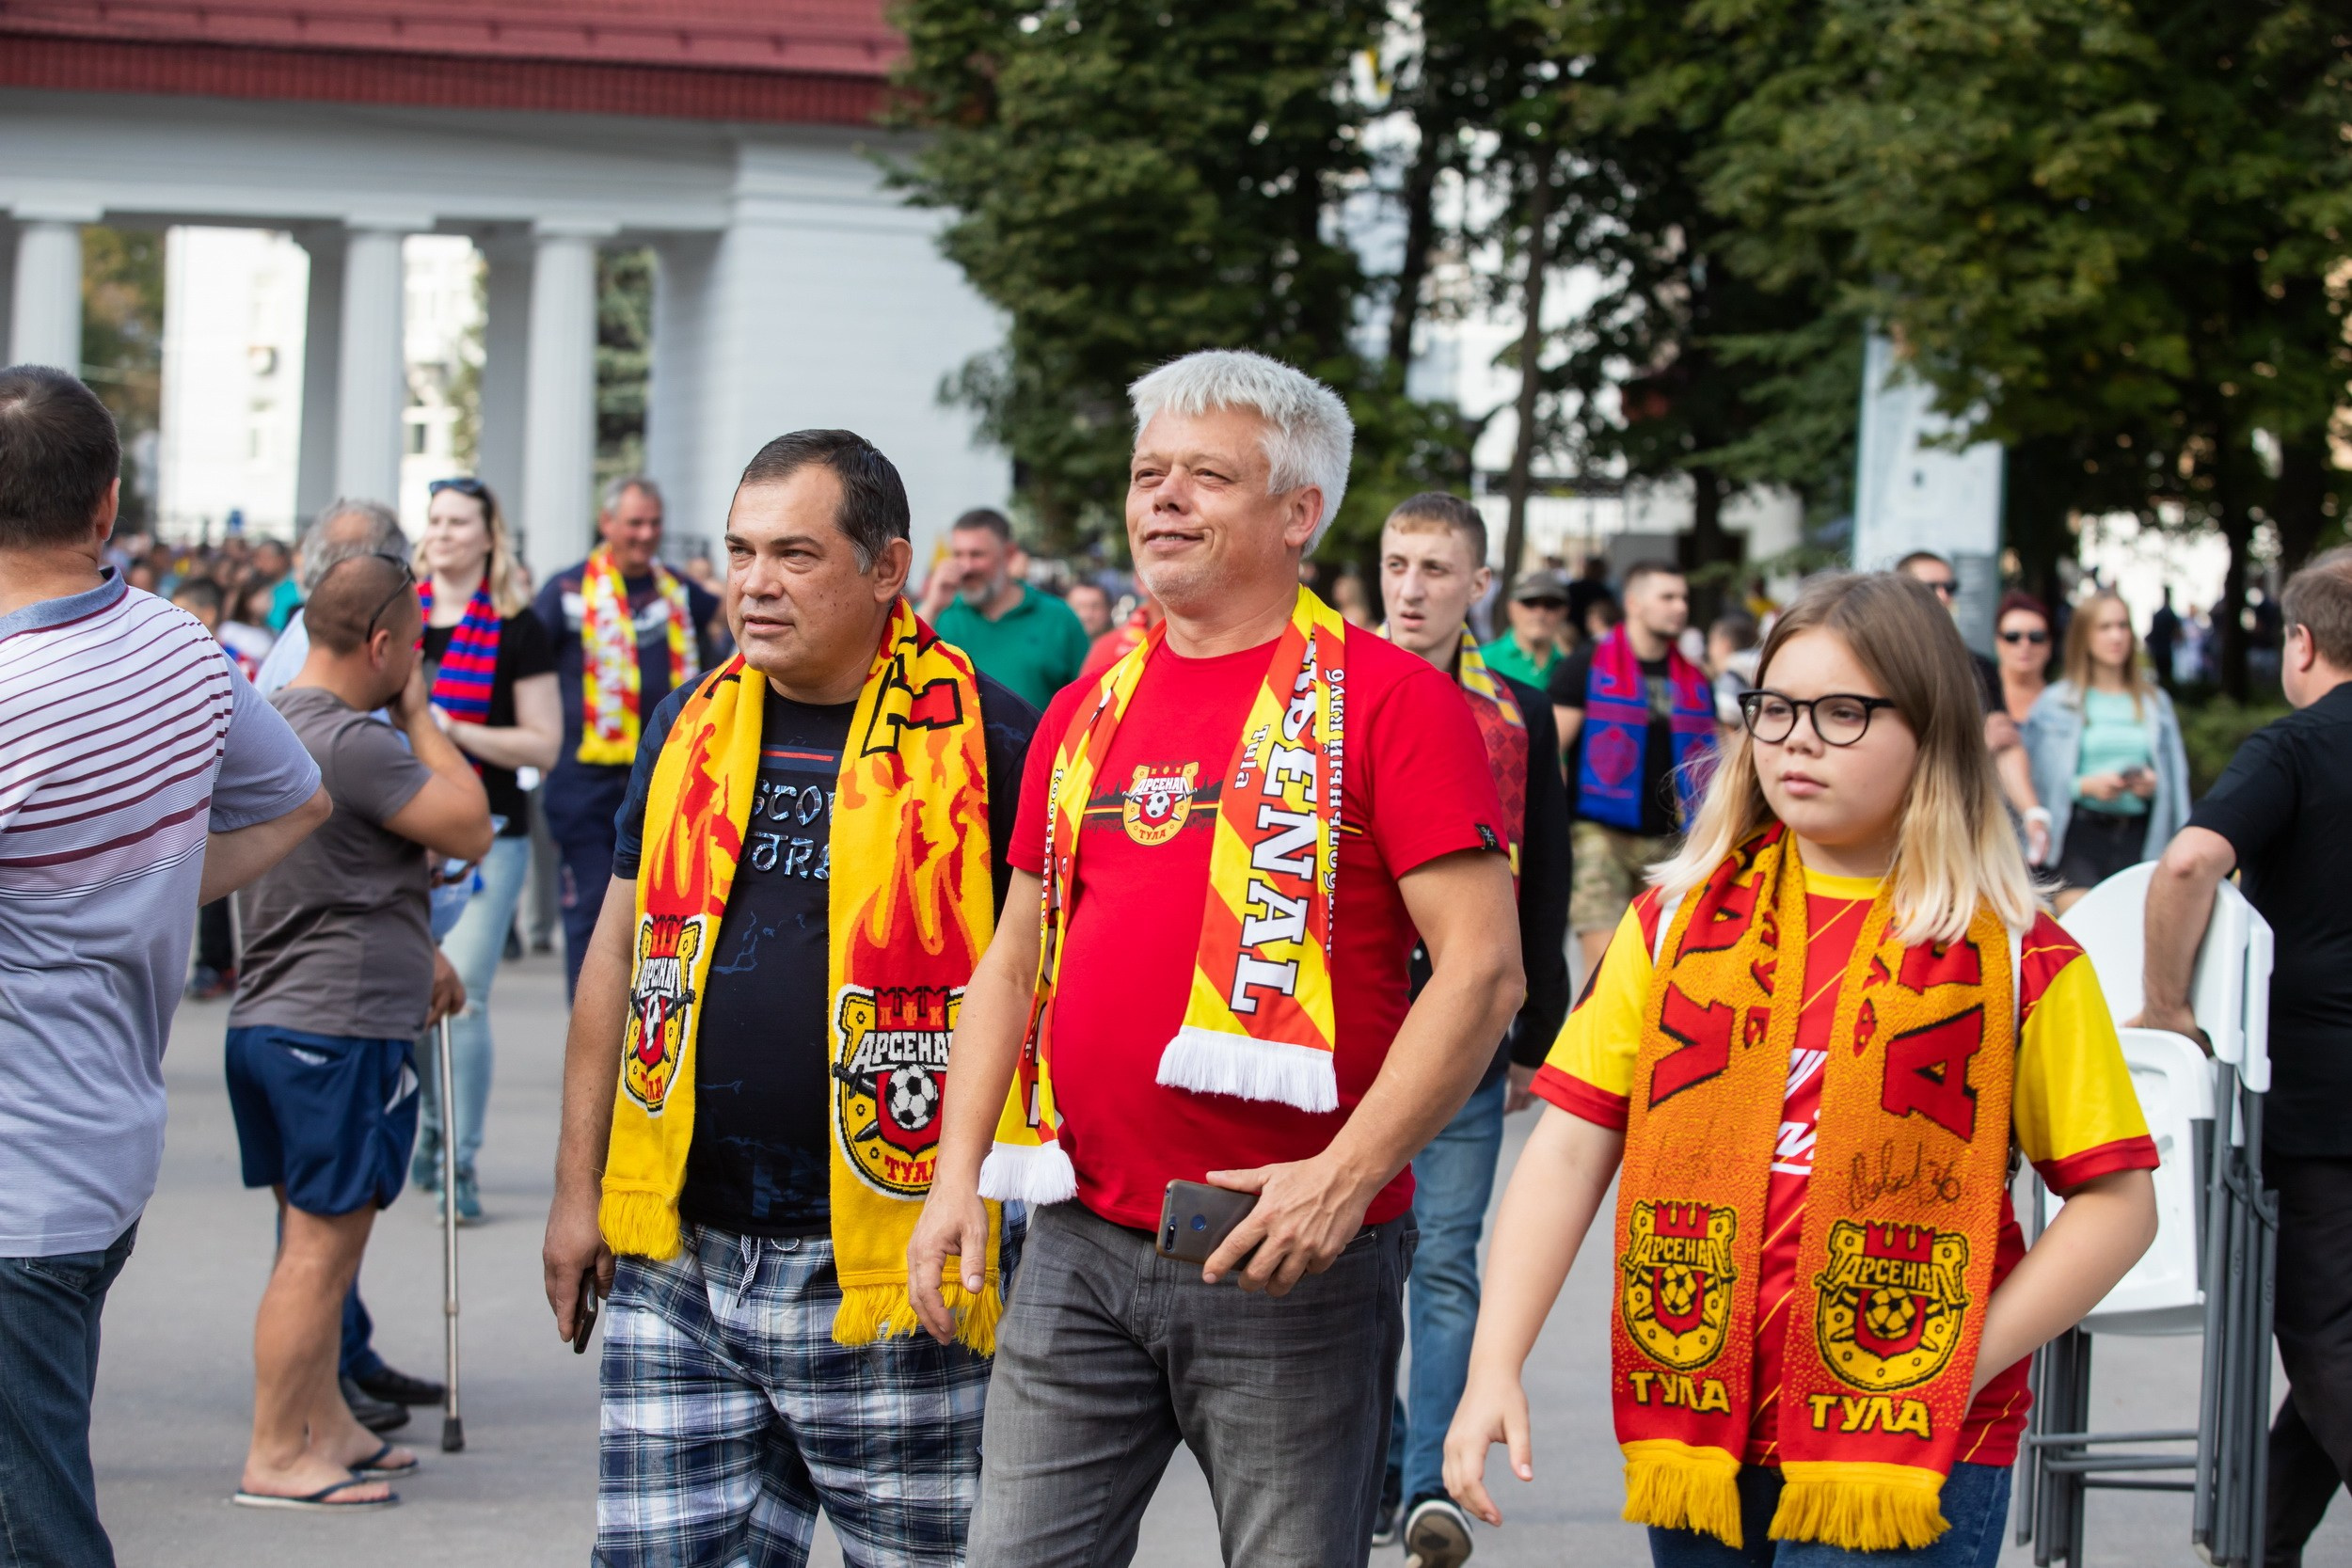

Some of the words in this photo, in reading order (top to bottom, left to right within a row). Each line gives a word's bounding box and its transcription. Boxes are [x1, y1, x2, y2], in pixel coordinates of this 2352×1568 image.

[1326, 669, 1345, 732] клуб
[1233, 724, 1271, 789] Tula
[1131, 776, 1191, 796] АРСЕНАЛ
[1139, 829, 1167, 840] ТУЛА
[1229, 632, 1317, 1016] SENAL
[1323, 739, 1343, 958] больный
[849, 1032, 954, 1074] АРСЕНА
[1634, 1233, 1732, 1277] АРСЕНАЛ
[1831, 1253, 1963, 1306] АРСЕНАЛ
[1628, 1370, 1732, 1416] ТУЛА
[1806, 1394, 1933, 1441] ТУЛА
